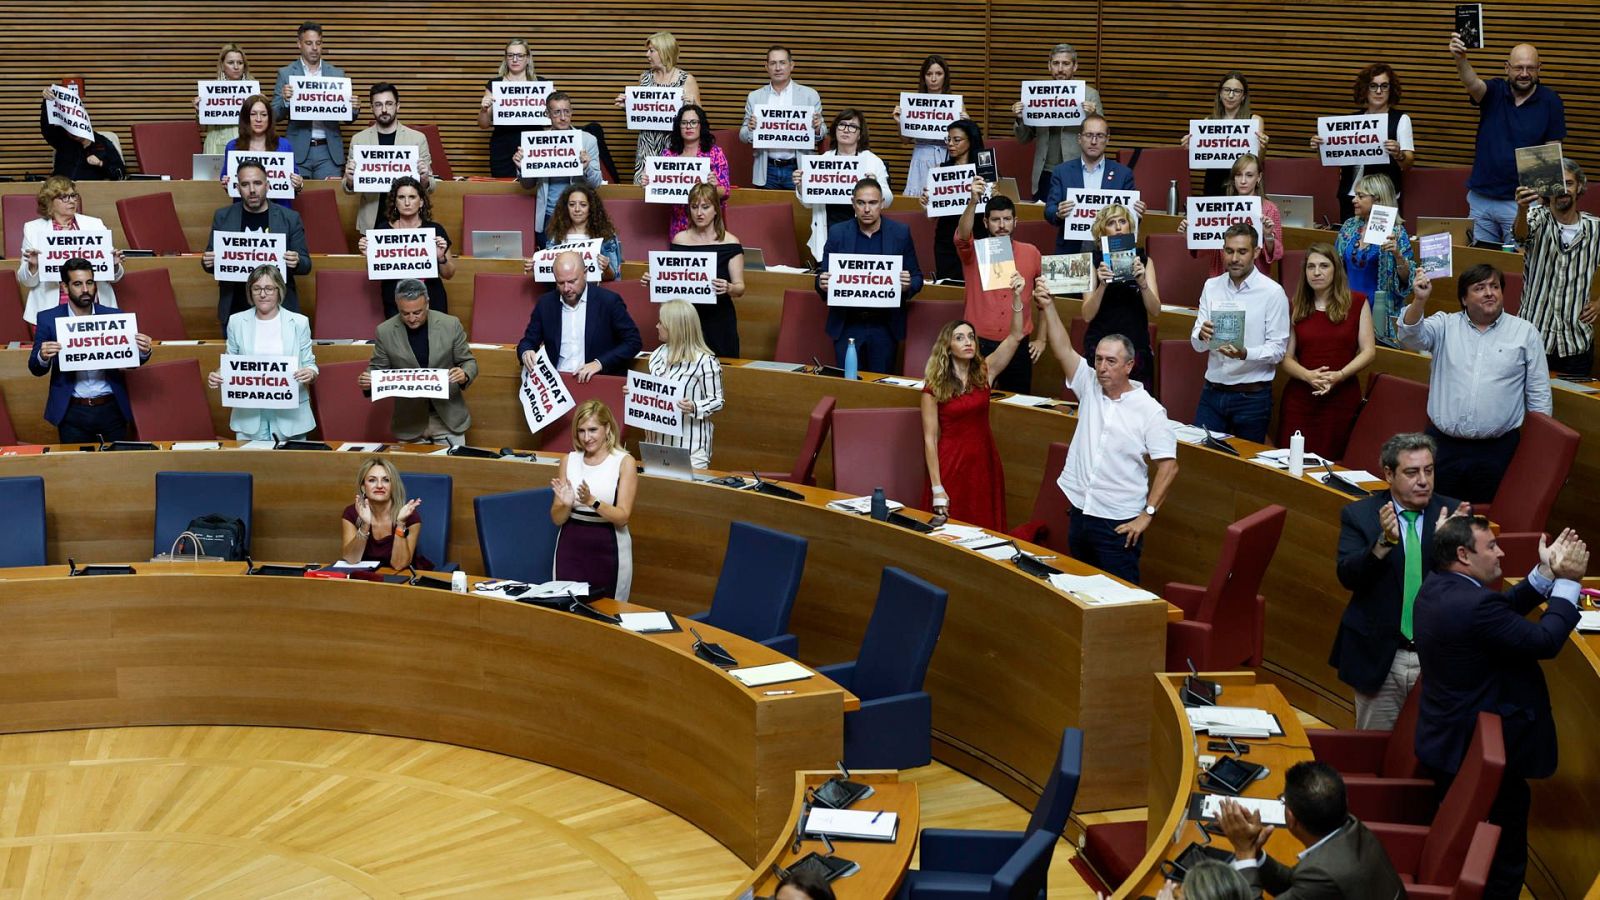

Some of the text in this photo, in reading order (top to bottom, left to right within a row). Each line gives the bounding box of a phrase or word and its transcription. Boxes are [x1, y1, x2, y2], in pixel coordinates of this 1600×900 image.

[206, 85, 253, 94] VERITAT
[297, 81, 344, 91] VERITAT
[500, 86, 546, 95] VERITAT
[1028, 85, 1076, 95] VERITAT
[296, 92, 345, 103] JUSTÍCIA
[632, 91, 676, 100] VERITAT
[499, 96, 546, 107] JUSTÍCIA
[632, 101, 676, 112] JUSTÍCIA
[908, 98, 955, 108] VERITAT
[1027, 96, 1077, 108] JUSTÍCIA
[204, 110, 240, 118] REPARA
[294, 104, 347, 114] REPARACIÓ
[760, 109, 807, 119] VERITAT
[1026, 108, 1080, 119] REPARACIÓ
[906, 109, 954, 121] JUSTÍCIA
[760, 120, 808, 131] JUSTÍCIA
[1198, 125, 1250, 135] VERITAT
[1326, 119, 1379, 132] VERITAT
[527, 135, 574, 145] VERITAT
[757, 131, 810, 142] REPARACIÓ
[1196, 136, 1250, 148] JUSTÍCIA
[1326, 131, 1380, 145] JUSTÍCIA
[361, 150, 411, 160] VERITAT
[527, 146, 576, 158] JUSTÍCIA
[1325, 147, 1383, 159] REPARACIÓ
[360, 161, 412, 172] JUSTÍCIA
[526, 158, 579, 170] REPARACIÓ
[654, 161, 702, 171] VERITAT
[810, 161, 859, 170] VERITAT
[652, 173, 702, 184] JUSTÍCIA
[808, 172, 859, 184] JUSTÍCIA
[933, 170, 975, 182] VERITA
[651, 188, 689, 196] REPARA
[933, 183, 971, 196] JUSTÍC
[1075, 194, 1131, 205] VERITAT
[1195, 201, 1253, 212] VERITAT
[47, 236, 103, 246] VERITAT
[222, 237, 277, 248] VERITAT
[374, 233, 427, 244] VERITAT
[222, 249, 278, 262] JUSTÍCIA
[374, 246, 429, 259] JUSTÍCIA
[373, 259, 432, 271] REPARACIÓ
[657, 256, 708, 267] VERITAT
[837, 259, 893, 270] VERITAT
[656, 268, 708, 281] JUSTÍCIA
[836, 271, 893, 285] JUSTÍCIA
[654, 283, 712, 296] REPARACIÓ
[833, 287, 895, 299] REPARACIÓ
[66, 319, 127, 333] VERITAT
[66, 333, 129, 348] JUSTÍCIA
[65, 348, 133, 362] REPARACIÓ
[229, 360, 289, 372] VERITAT
[229, 373, 289, 387] JUSTÍCIA
[379, 373, 440, 383] JUSTÍCIA
[536, 355, 567, 405] VERITAT
[377, 384, 443, 392] REPARACIÓ
[633, 377, 677, 397] VERITAT
[227, 388, 293, 401] REPARACIÓ
[631, 393, 675, 412] JUSTÍCIA
[628, 408, 677, 427] REPARACIÓ
